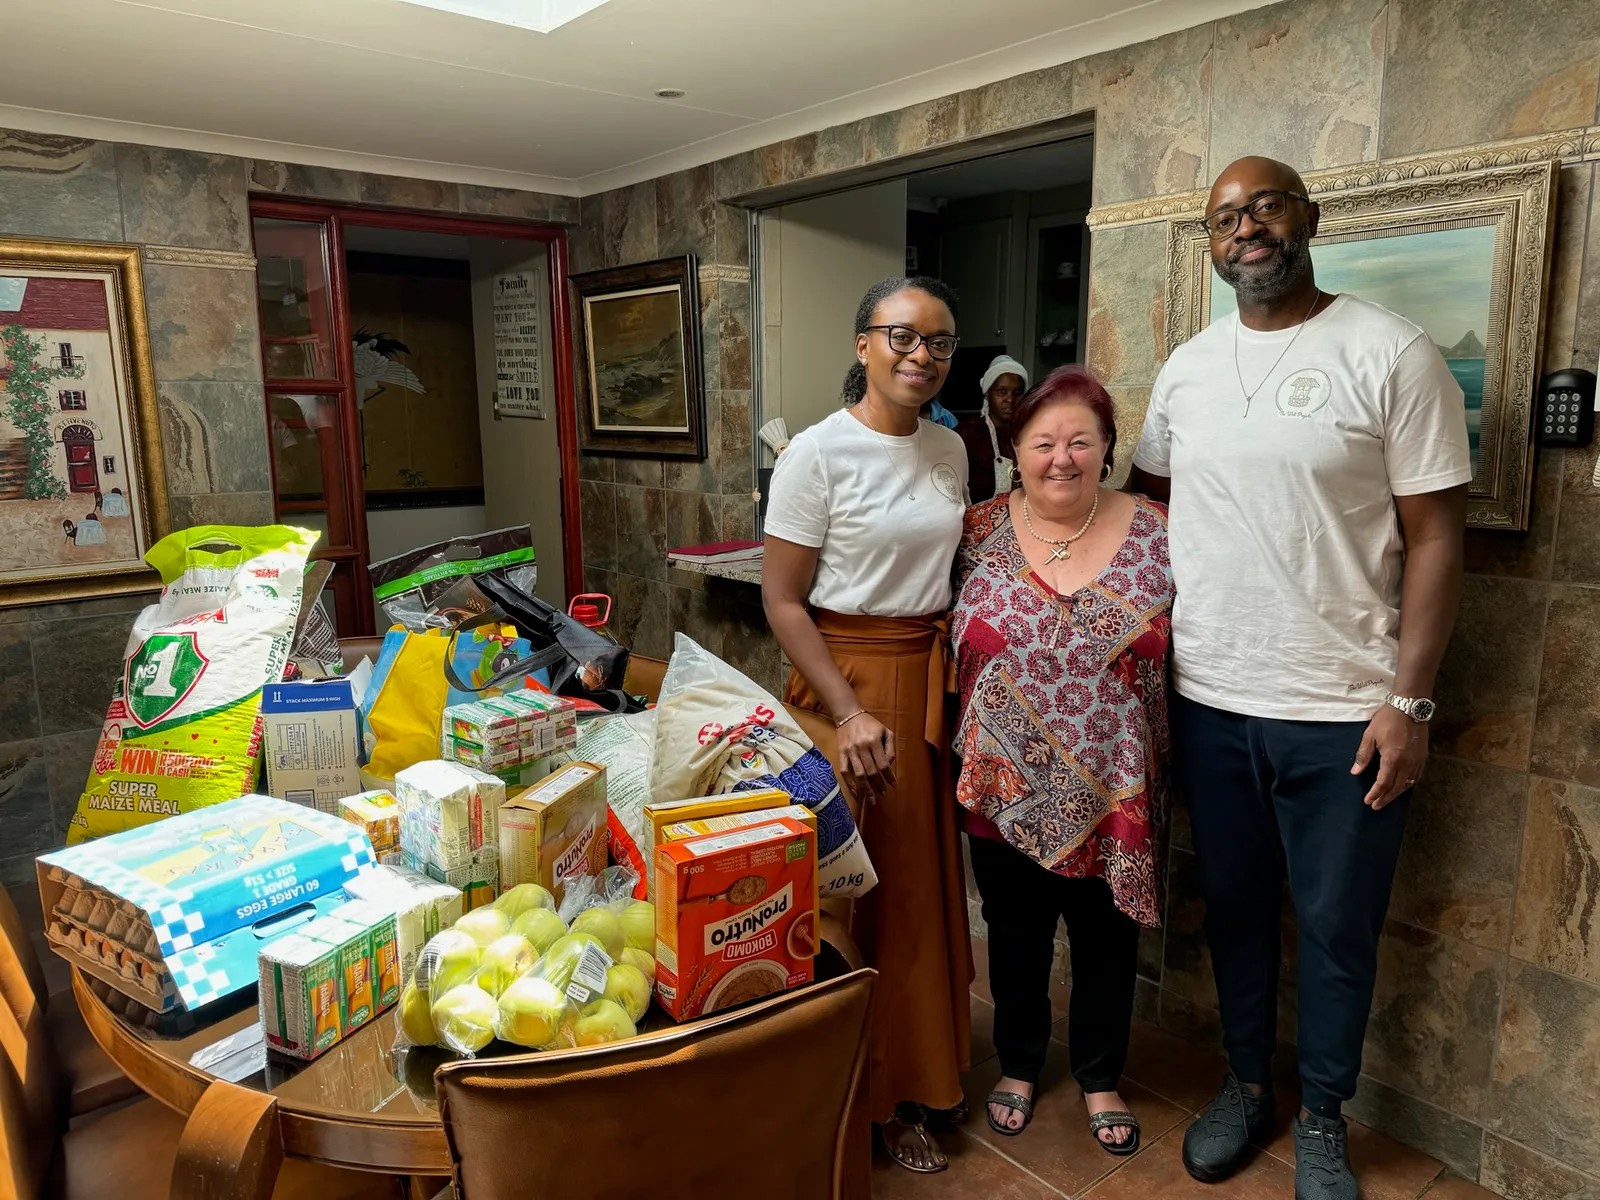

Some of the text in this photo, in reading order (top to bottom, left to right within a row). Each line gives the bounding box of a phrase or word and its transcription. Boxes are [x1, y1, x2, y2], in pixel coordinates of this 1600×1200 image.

[499, 276, 528, 295] Family
[120, 748, 158, 775] WIN
[158, 766, 166, 776] IN
[167, 767, 189, 778] CASH
[109, 781, 157, 797] SUPER
[88, 796, 181, 815] MAIZE MEAL
[830, 853, 841, 864] goes
[274, 862, 297, 878] SIZE
[690, 865, 704, 874] 500
[262, 875, 298, 896] GRADE
[829, 872, 864, 890] 10 kg
[236, 878, 320, 919] 60 LARGE EGGS
[711, 894, 786, 946] ProNutro
[729, 934, 772, 957] BOKOMO
[385, 944, 393, 974] MANGO
[352, 963, 362, 994] MANGO
[320, 983, 329, 1016] MANGO
